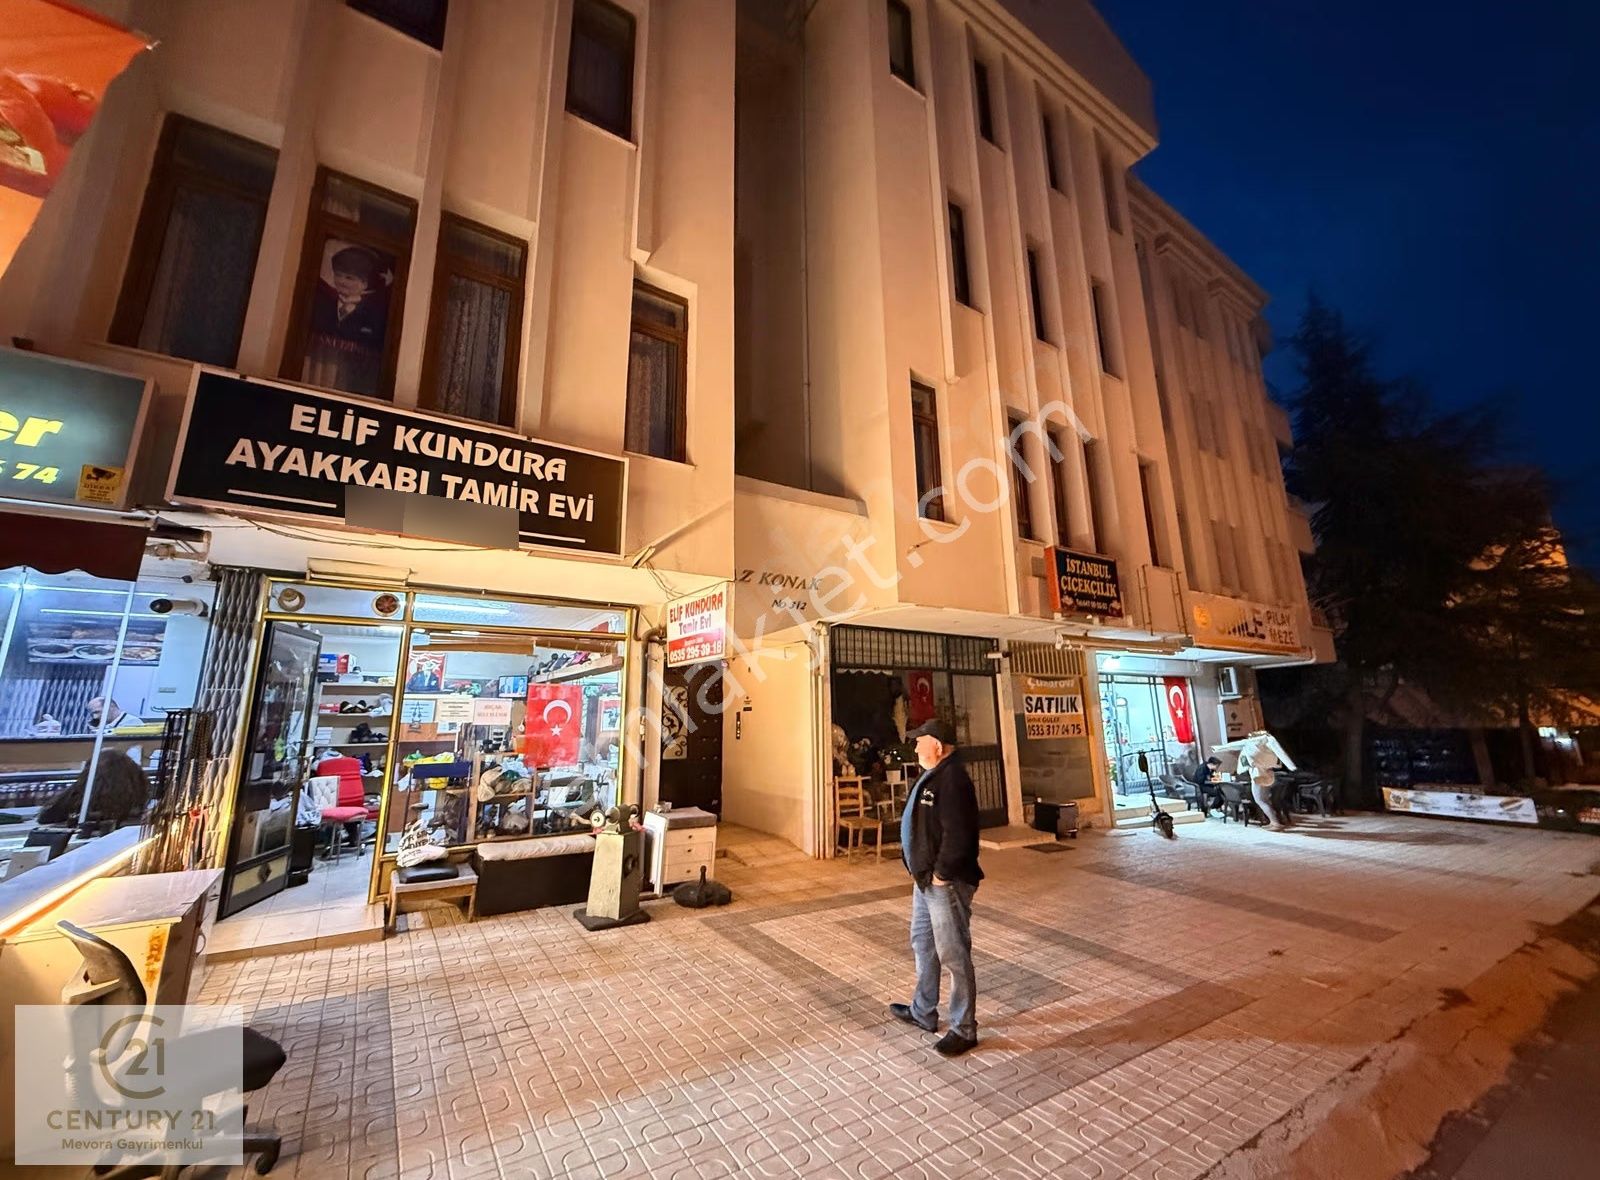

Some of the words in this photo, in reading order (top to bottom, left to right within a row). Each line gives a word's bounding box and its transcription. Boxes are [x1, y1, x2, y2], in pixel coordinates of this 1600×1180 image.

[290, 404, 380, 446] ELİF
[393, 425, 567, 482] KUNDURA
[12, 462, 60, 484] 74
[225, 437, 430, 495] AYAKKABI
[441, 473, 540, 514] TAMİR
[548, 493, 595, 522] EVİ
[1066, 555, 1112, 580] İSTANBUL
[1060, 573, 1118, 599] ÇİÇEKÇİLİK
[669, 602, 684, 624] ELİF
[684, 591, 724, 620] KUNDURA
[1025, 695, 1079, 714] SATILIK
[1071, 723, 1082, 735] 75
